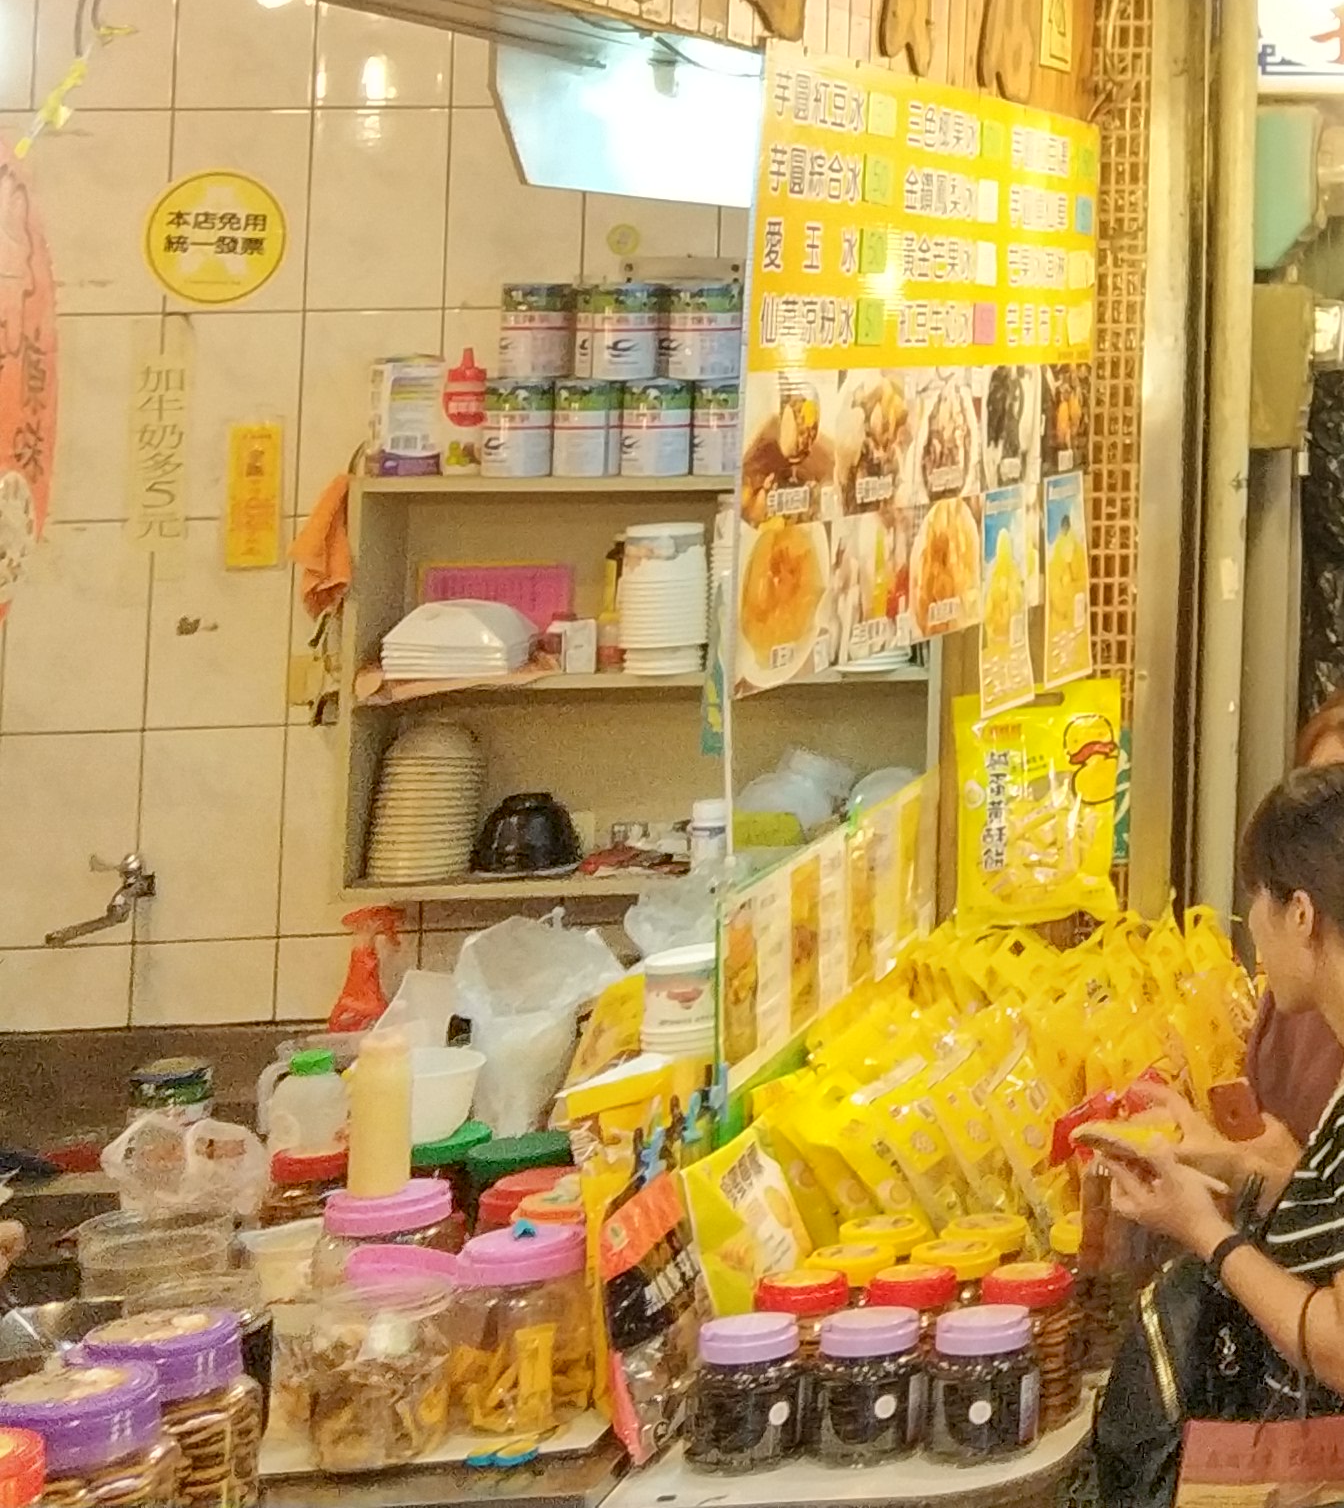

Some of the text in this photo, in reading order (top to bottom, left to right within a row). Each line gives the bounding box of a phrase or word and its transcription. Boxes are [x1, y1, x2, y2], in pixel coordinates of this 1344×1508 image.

[165, 210, 268, 233] 本店免用
[162, 234, 268, 257] 統一發票
[136, 366, 186, 542] 加牛奶多5元
